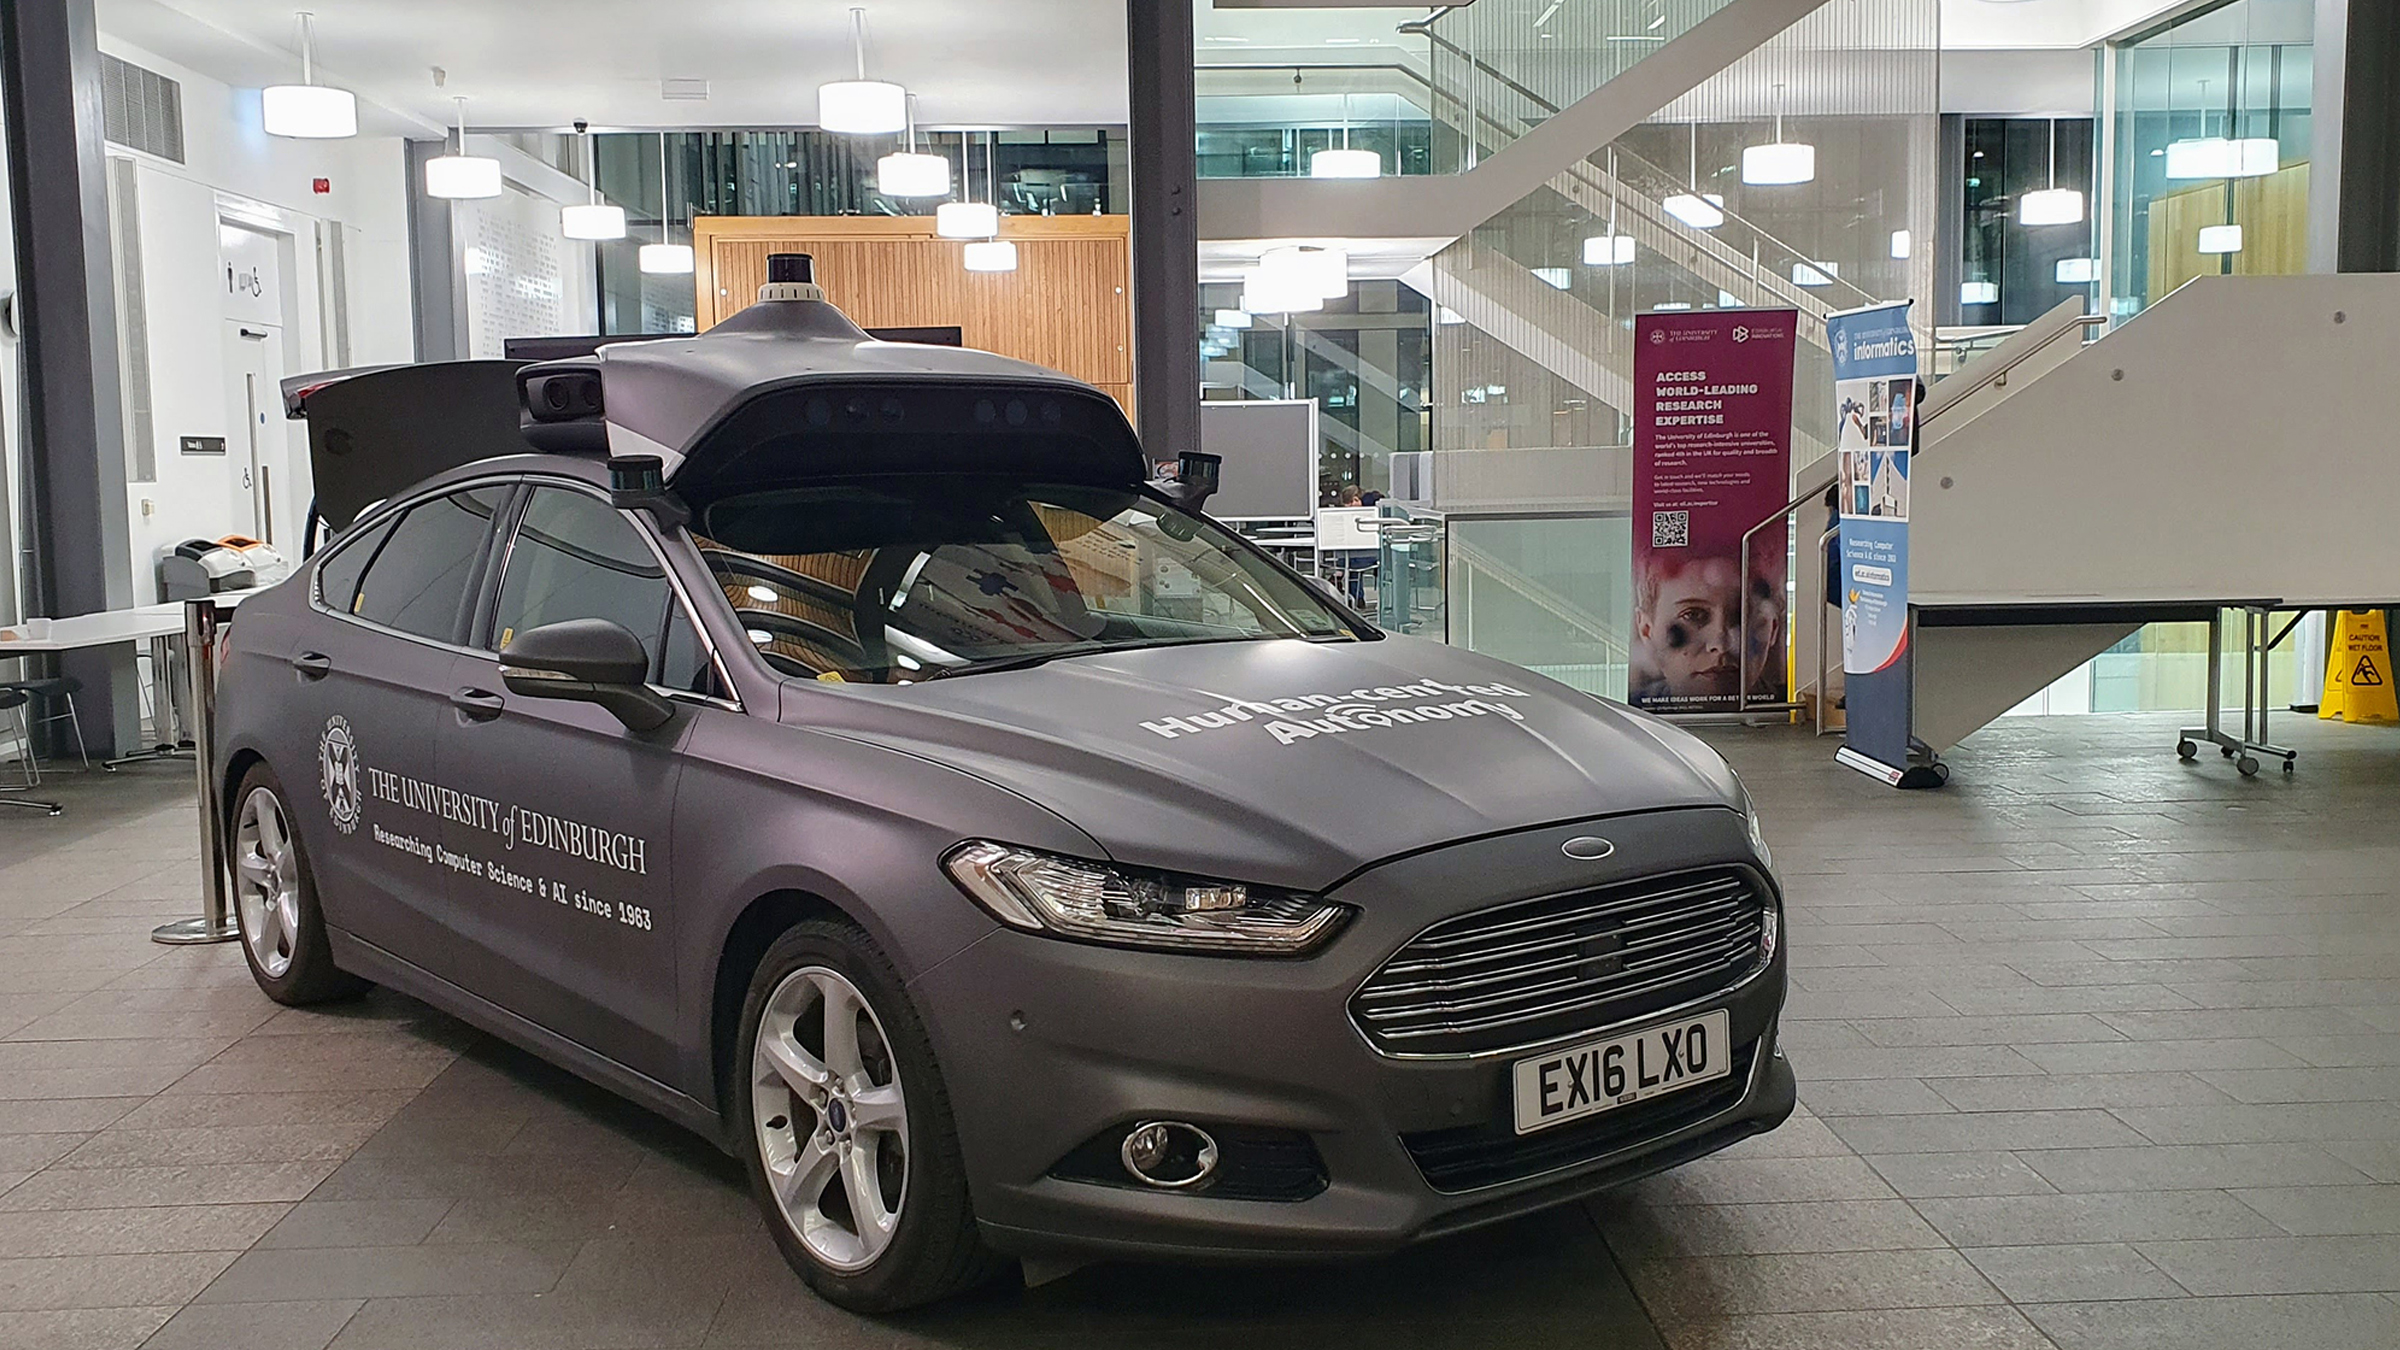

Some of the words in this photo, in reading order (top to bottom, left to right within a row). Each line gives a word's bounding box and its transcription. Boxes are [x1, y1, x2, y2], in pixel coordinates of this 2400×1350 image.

[1854, 337, 1914, 360] informatics
[1656, 371, 1706, 382] ACCESS
[1656, 384, 1758, 397] WORLD-LEADING
[1656, 400, 1722, 411] RESEARCH
[1655, 414, 1723, 426] EXPERTISE
[1263, 699, 1525, 746] Autonomy
[368, 767, 400, 804] THE
[402, 776, 499, 833] UNIVERSITY
[502, 805, 518, 850] of
[521, 809, 647, 875] EDINBURGH
[373, 823, 433, 864] Researching
[436, 844, 483, 877] Computer
[488, 861, 533, 893] Science
[539, 878, 547, 898] &
[553, 881, 568, 905] AI
[575, 889, 612, 918] since
[619, 902, 652, 931] 1963
[1539, 1045, 1625, 1116] EX16
[1637, 1023, 1708, 1089] LXO
